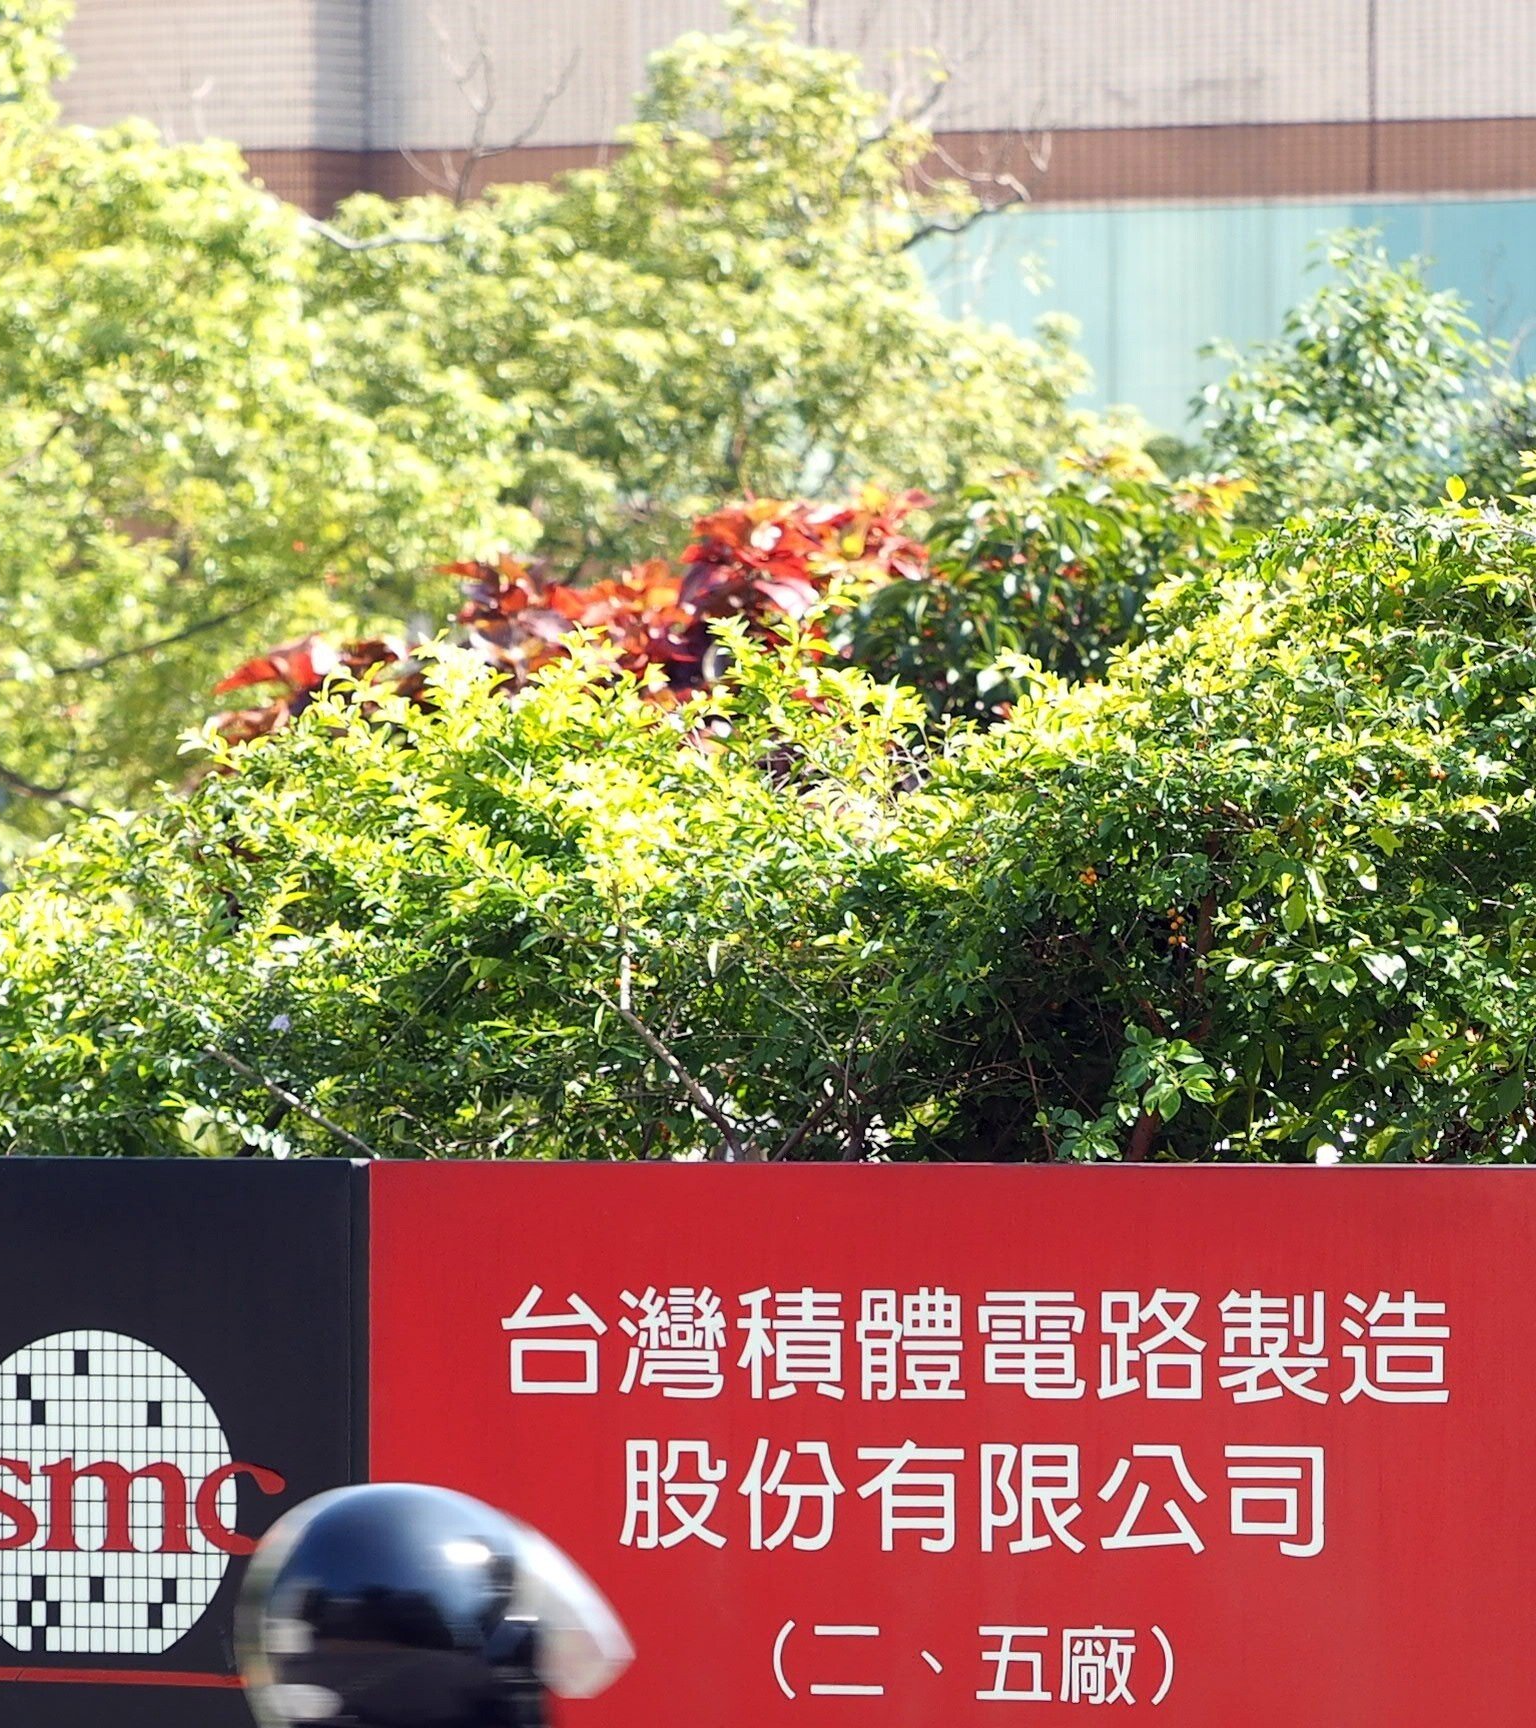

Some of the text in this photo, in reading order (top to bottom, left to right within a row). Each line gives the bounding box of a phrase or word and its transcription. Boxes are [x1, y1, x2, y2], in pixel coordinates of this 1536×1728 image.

[500, 1283, 1451, 1406] 台灣積體電路製造
[618, 1436, 1328, 1559] 股份有限公司
